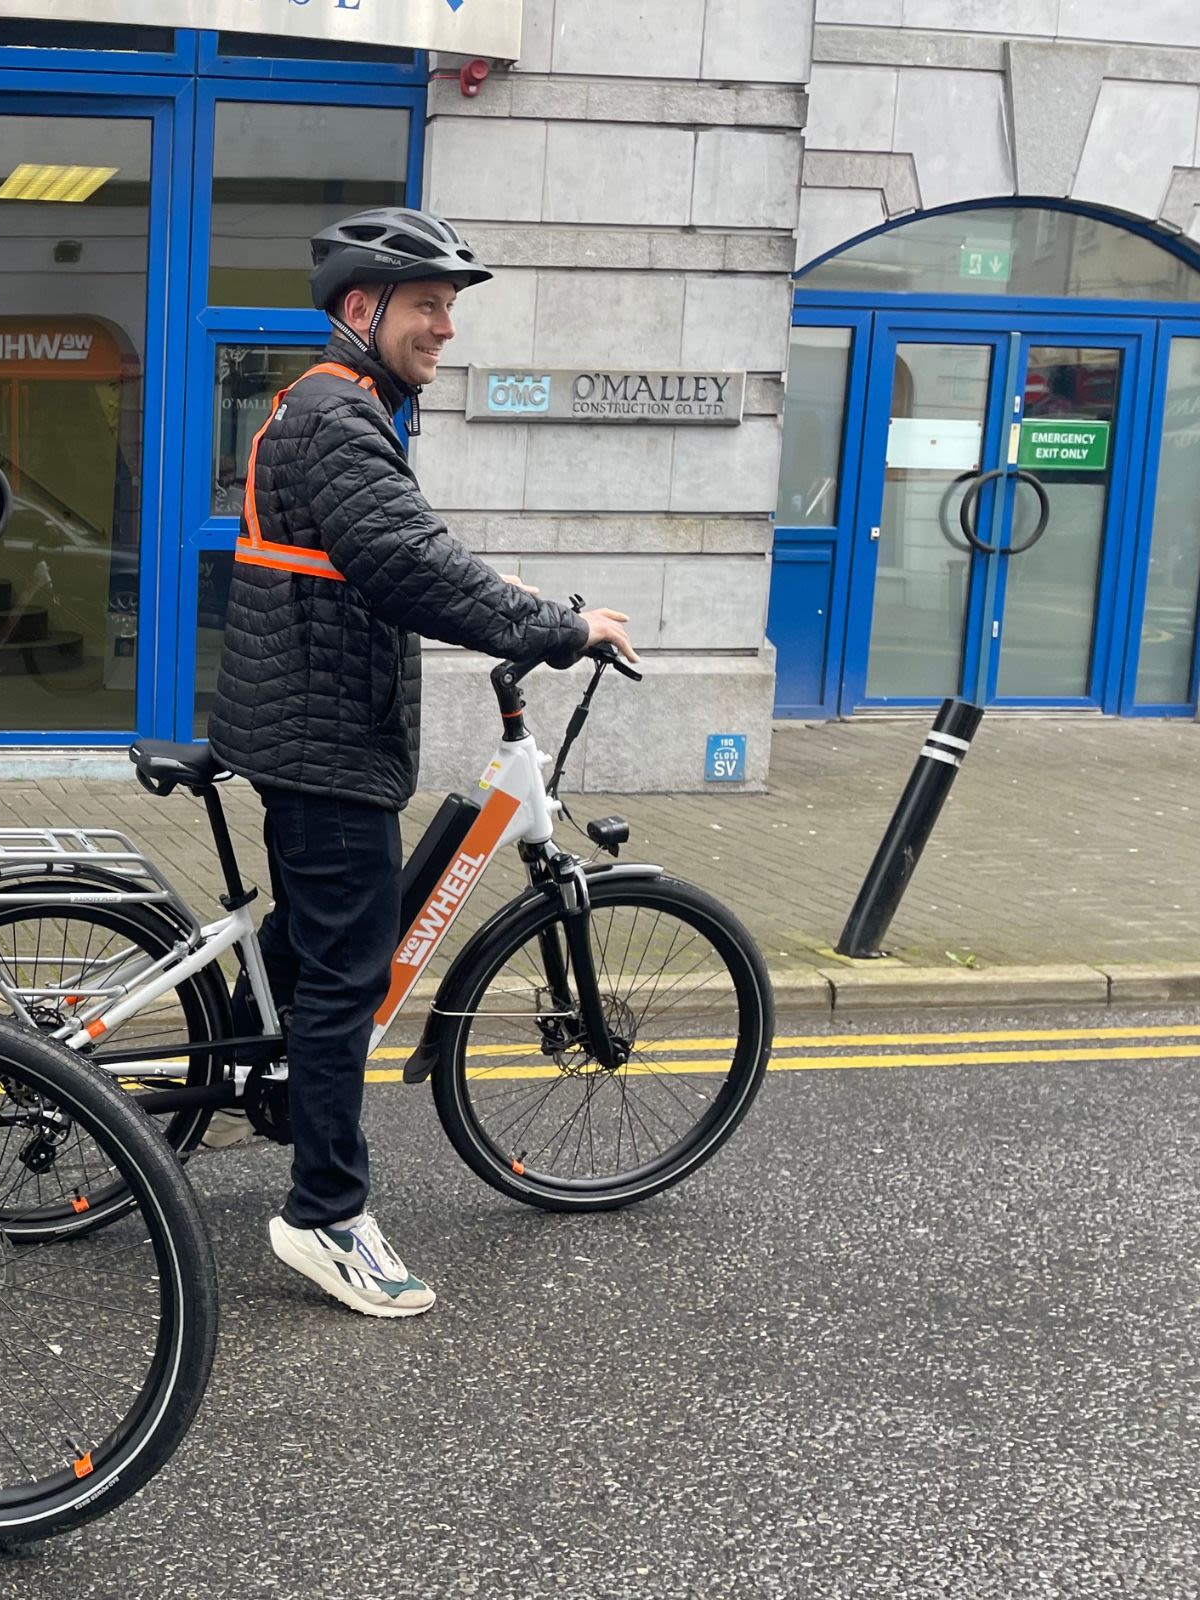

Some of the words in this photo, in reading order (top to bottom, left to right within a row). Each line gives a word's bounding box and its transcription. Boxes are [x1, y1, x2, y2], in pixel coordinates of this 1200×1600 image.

[374, 254, 402, 266] SENA
[573, 373, 731, 402] O'MALLEY
[573, 402, 669, 415] CONSTRUCTION
[1031, 432, 1096, 445] EMERGENCY
[1035, 447, 1059, 459] EXIT
[1060, 448, 1089, 460] ONLY
[713, 751, 739, 760] CLOSE
[713, 760, 737, 777] SV
